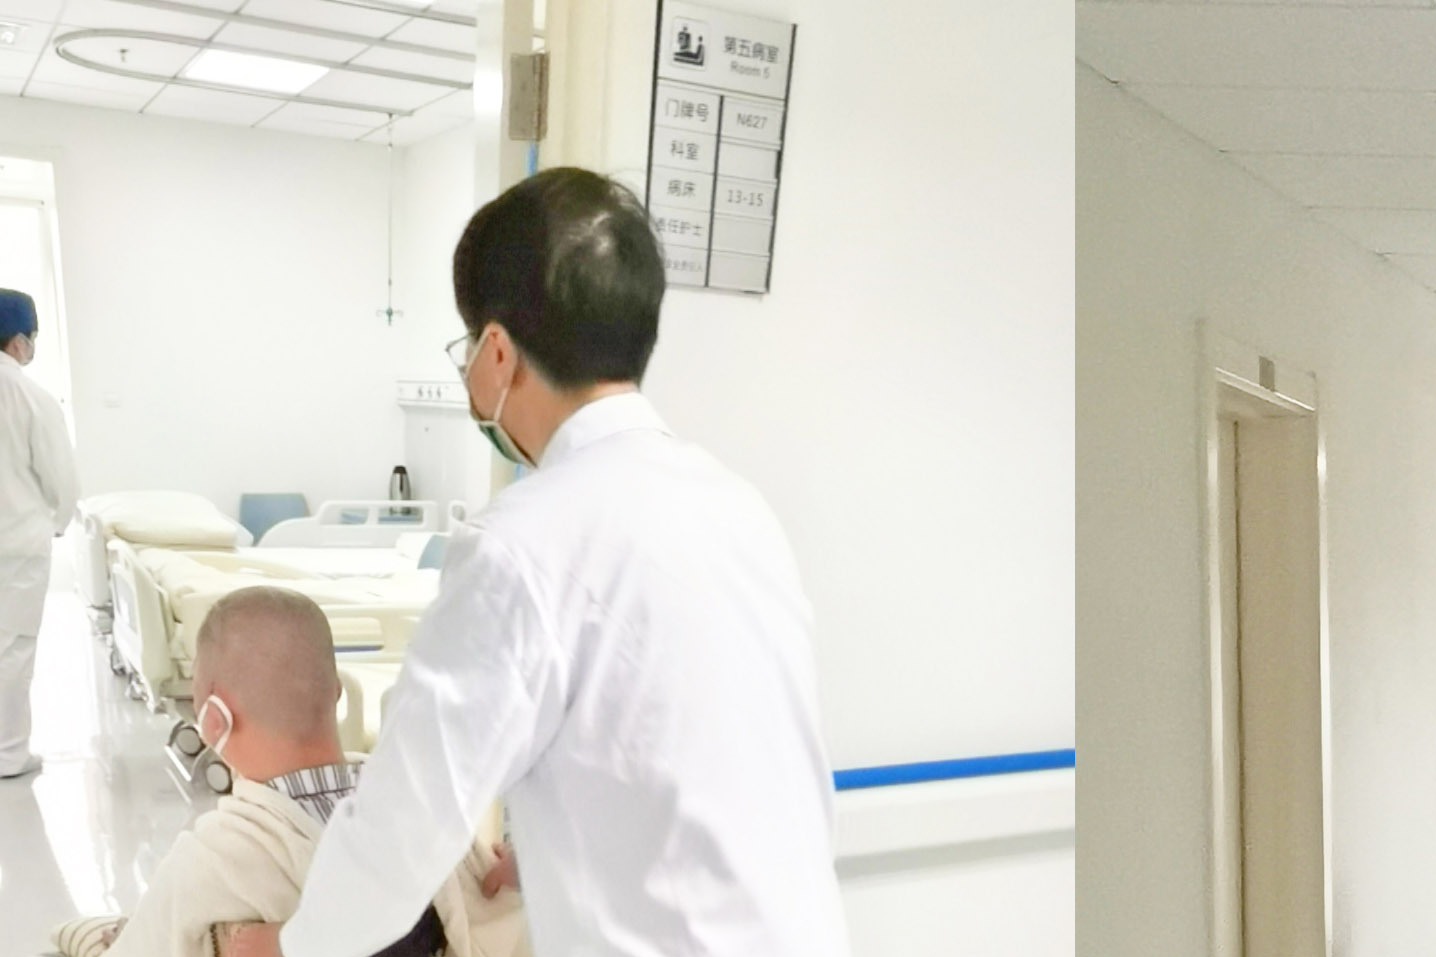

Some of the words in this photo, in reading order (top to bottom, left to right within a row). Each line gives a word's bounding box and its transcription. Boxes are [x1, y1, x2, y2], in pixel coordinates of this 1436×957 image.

[665, 99, 709, 122] 门牌号
[671, 140, 699, 160] 科室
